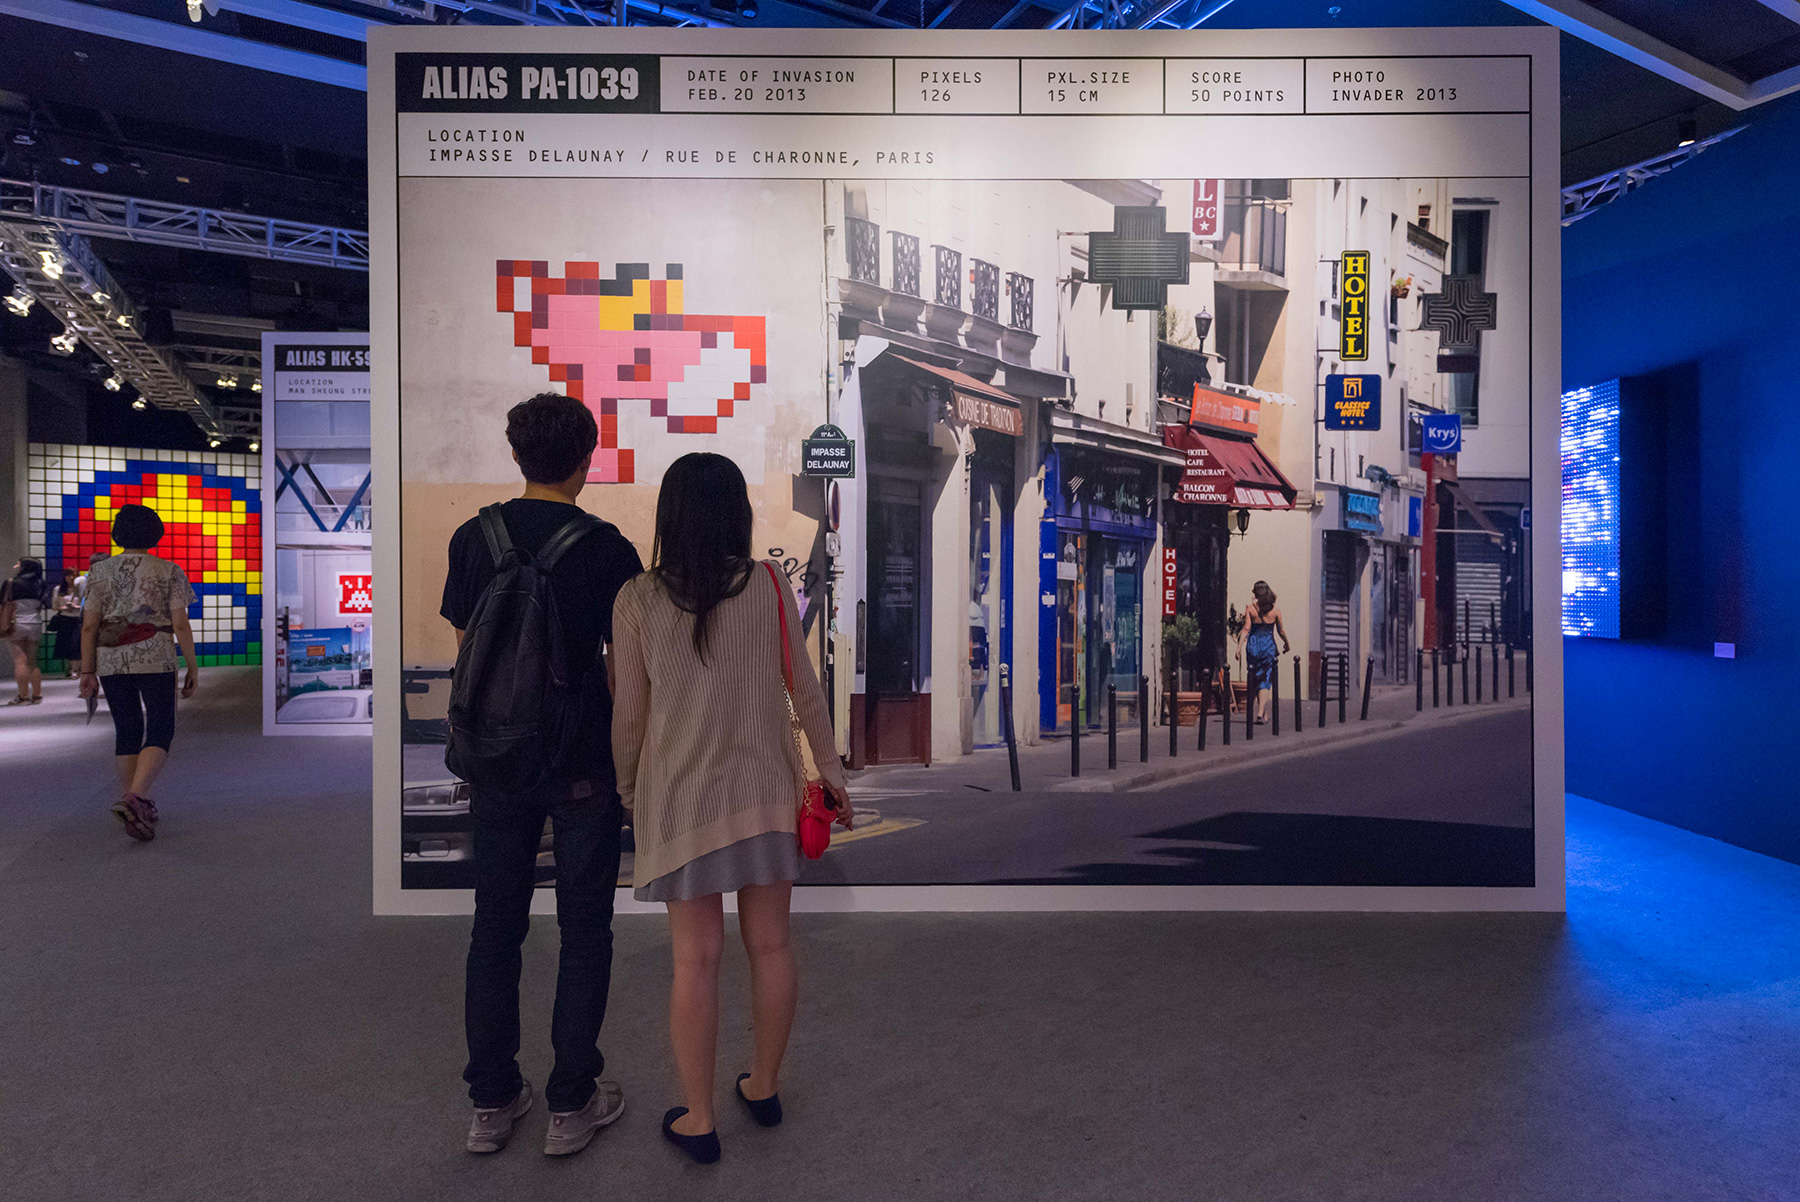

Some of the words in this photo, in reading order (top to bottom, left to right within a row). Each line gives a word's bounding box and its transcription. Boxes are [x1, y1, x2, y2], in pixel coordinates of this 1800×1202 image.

[422, 66, 508, 100] ALIAS
[521, 66, 640, 100] PA-1039
[687, 69, 728, 83] DATE
[739, 69, 759, 83] OF
[772, 70, 856, 84] INVASION
[920, 70, 983, 85] PIXELS
[1047, 70, 1131, 85] PXL.SIZE
[1191, 70, 1243, 85] SCORE
[1332, 69, 1386, 84] PHOTO
[765, 87, 807, 102] 2013
[920, 88, 952, 103] 126
[1047, 88, 1067, 103] 15
[1078, 88, 1099, 103] CM
[1191, 88, 1211, 103] 50
[1223, 88, 1285, 103] POINTS
[1332, 87, 1405, 102] INVADER
[1416, 86, 1458, 101] 2013
[427, 129, 526, 143] LOCATION
[428, 148, 514, 163] IMPASSE
[528, 149, 626, 164] DELAUNAY
[641, 149, 650, 164] /
[665, 150, 700, 164] RUE
[715, 150, 738, 165] DE
[752, 150, 860, 168] CHARONNE,
[876, 151, 935, 165] PARIS
[1344, 256, 1367, 356] HOTEL
[286, 350, 326, 366] ALIAS
[331, 350, 370, 366] HK-59
[311, 387, 345, 395] SHEUNG
[351, 387, 371, 395] STR
[1334, 401, 1371, 410] CLASSICS
[1340, 409, 1366, 418] HOTEL
[1428, 427, 1456, 441] Krys
[811, 448, 846, 457] IMPASSE
[806, 460, 850, 469] DELAUNAY
[1183, 484, 1215, 493] BALCON
[1183, 492, 1228, 502] CHARONNE
[1164, 549, 1177, 614] HOTEL
